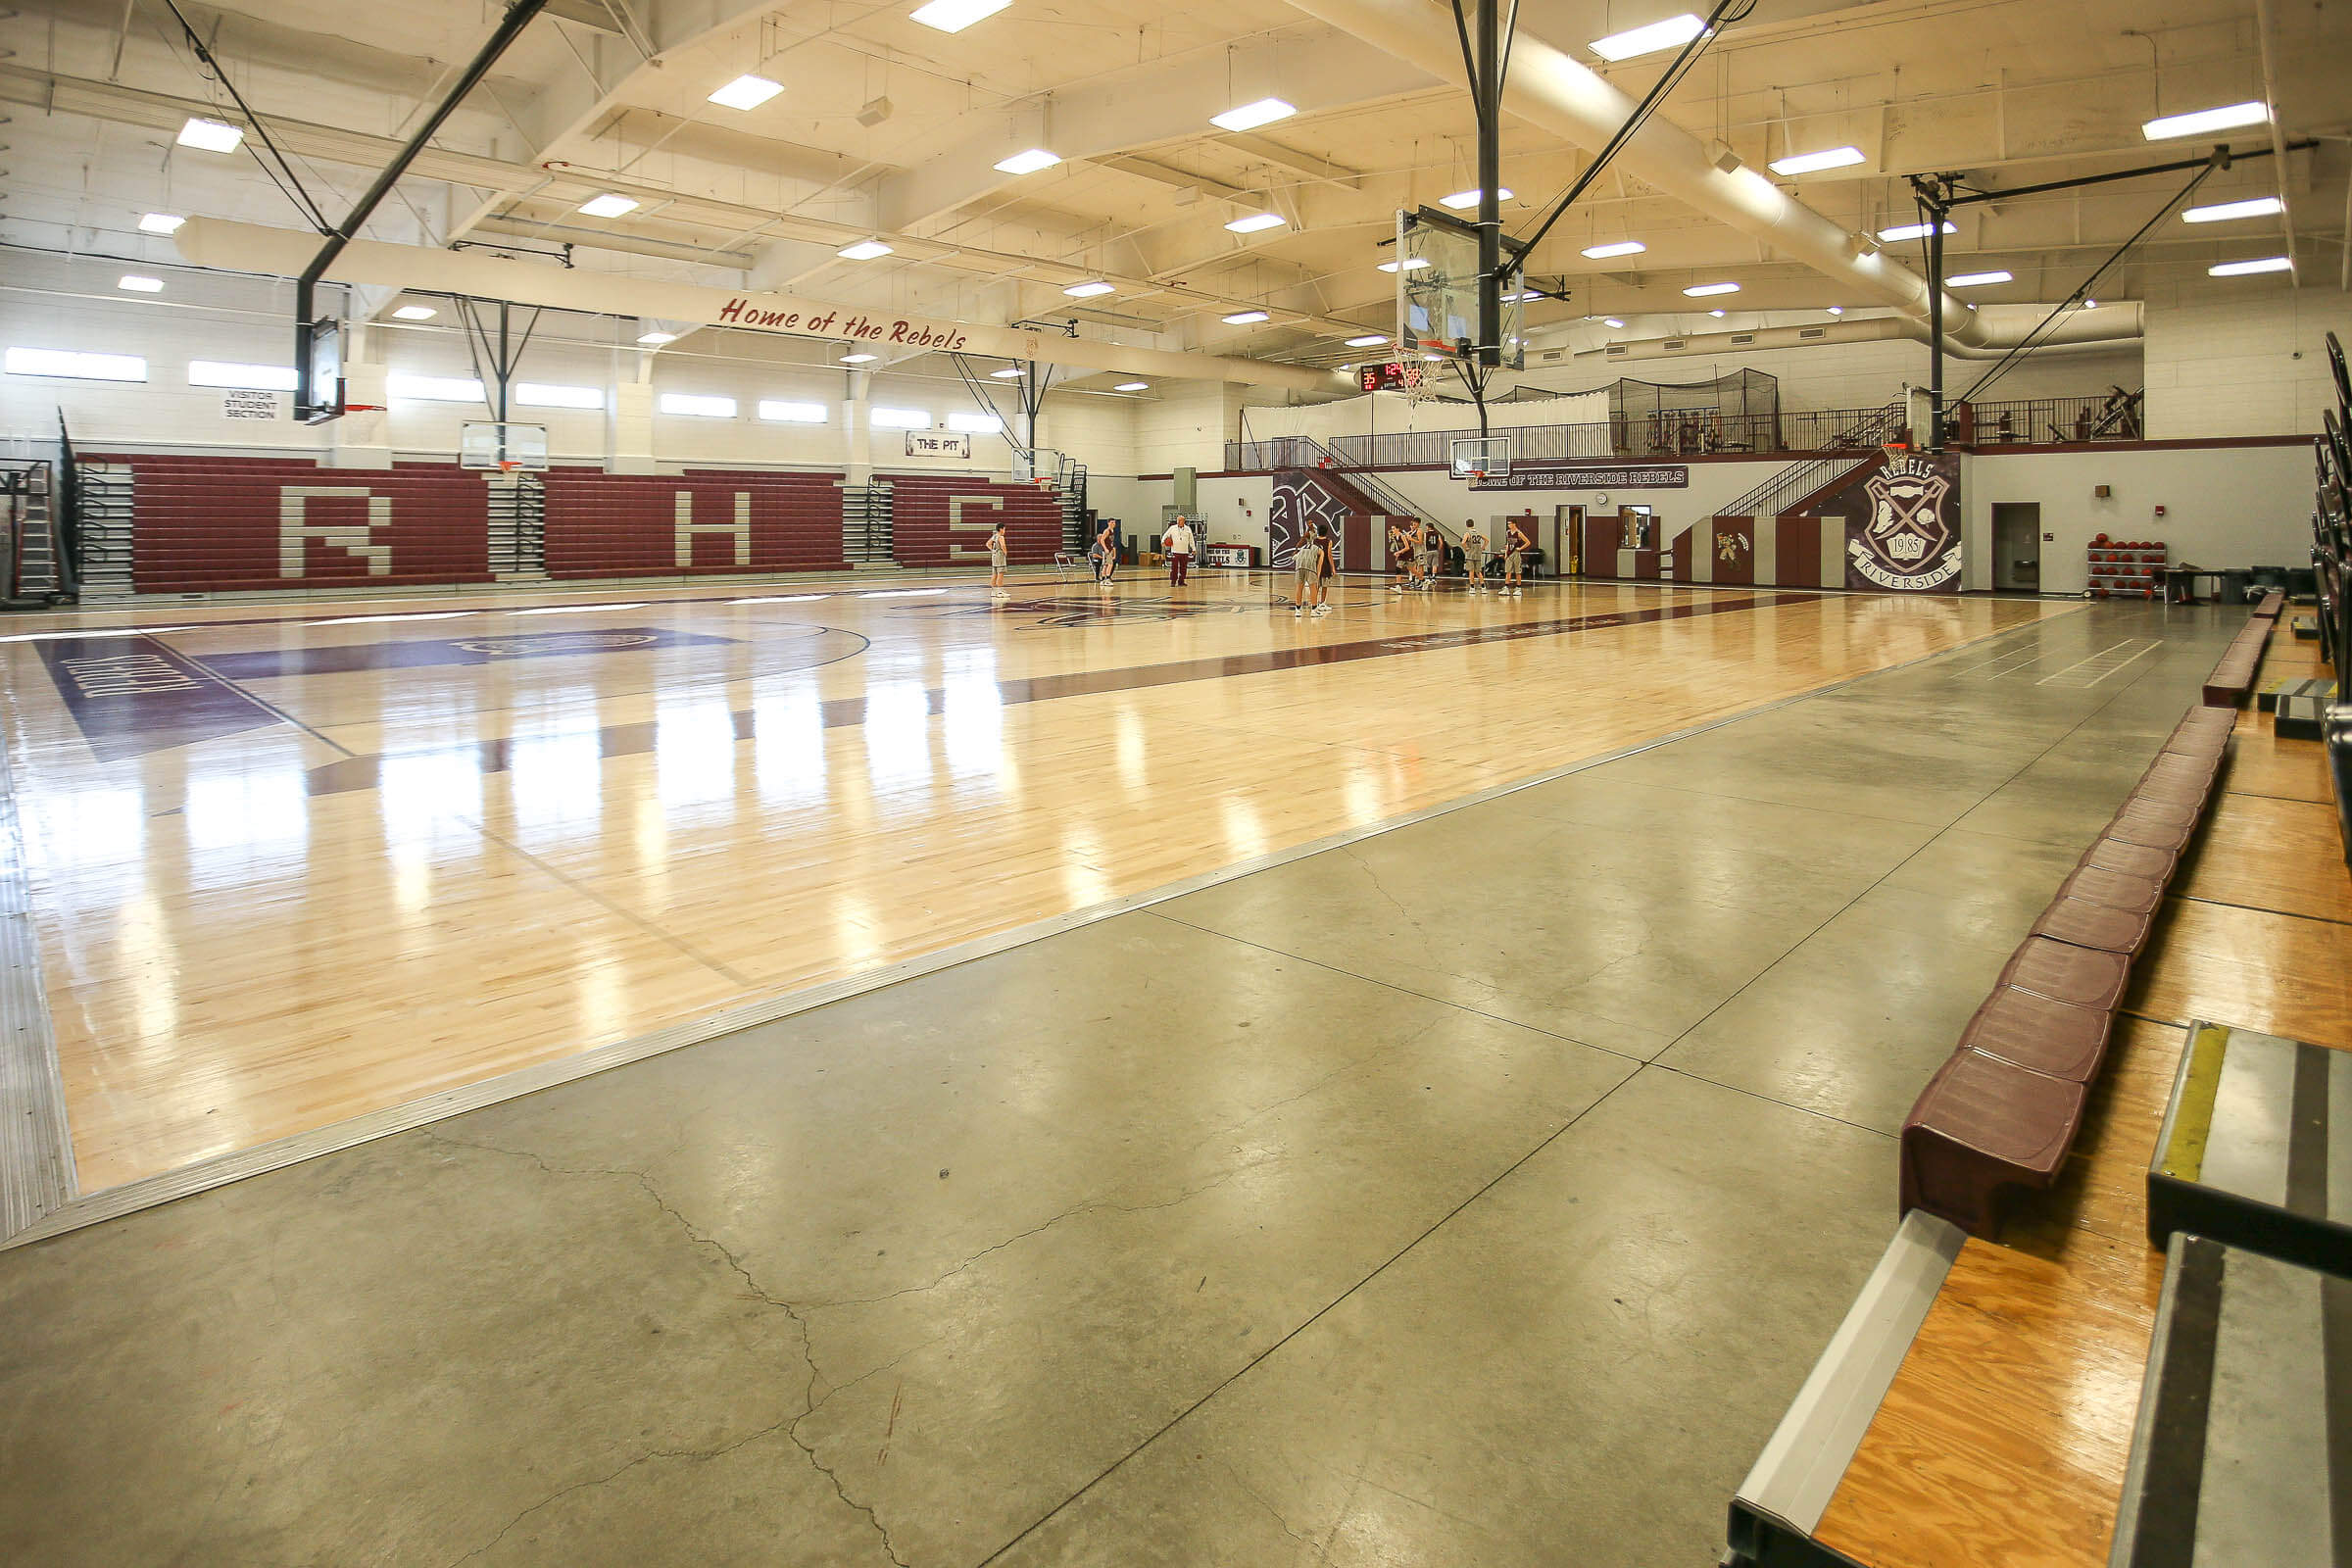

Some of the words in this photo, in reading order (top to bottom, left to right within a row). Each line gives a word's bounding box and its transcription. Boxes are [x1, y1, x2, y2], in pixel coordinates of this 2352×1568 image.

[718, 298, 800, 328] Home
[807, 311, 837, 332] of
[843, 316, 884, 340] the
[888, 319, 967, 351] Rebels
[1363, 372, 1376, 384] 35
[228, 390, 273, 400] VISITOR
[224, 399, 278, 410] STUDENT
[226, 409, 275, 419] SECTION
[916, 438, 939, 450] THE
[943, 440, 959, 451] PIT
[1880, 458, 1936, 480] REBELS
[1509, 474, 1526, 486] OF
[1527, 473, 1554, 486] THE
[1554, 472, 1628, 486] RIVERSIDE
[1629, 470, 1685, 484] REBELS
[279, 485, 392, 578] R
[674, 491, 750, 567] H
[1428, 535, 1437, 545] 41
[1471, 534, 1482, 545] 32
[1860, 562, 1955, 589] RIVERSIDE
